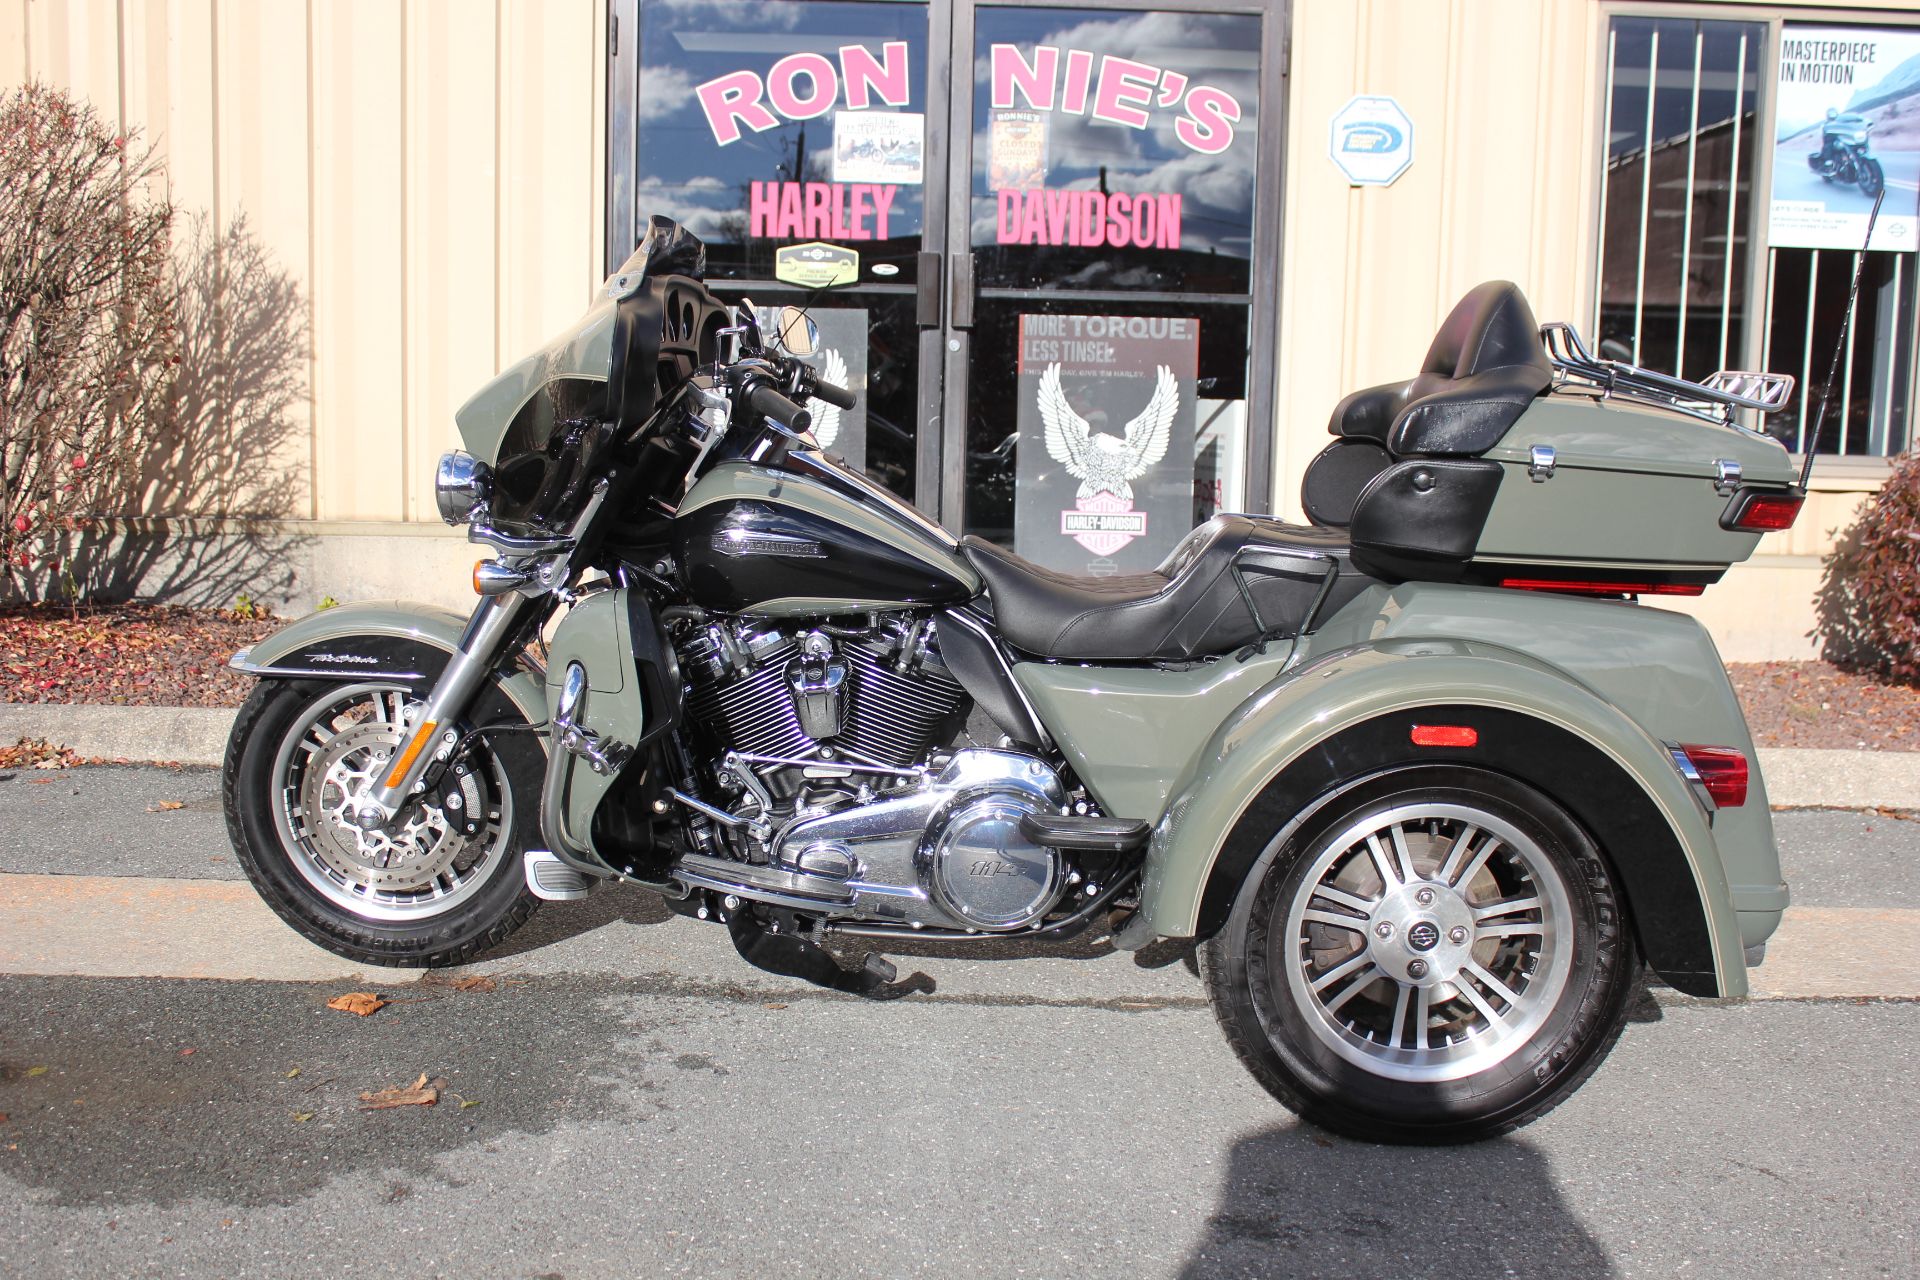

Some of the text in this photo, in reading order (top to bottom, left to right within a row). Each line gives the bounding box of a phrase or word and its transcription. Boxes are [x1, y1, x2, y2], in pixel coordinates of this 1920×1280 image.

[1782, 40, 1877, 64] MASTERPIECE
[1781, 62, 1854, 84] IN MOTION
[696, 41, 1241, 155] RON NIE'S
[996, 112, 1041, 122] RONNIE'S
[750, 181, 1182, 250] HARLEY DAVIDSON
[1024, 314, 1192, 340] MORE TORQUE.
[1024, 340, 1117, 363] LESS TINSEL.
[1067, 515, 1141, 530] HARLEY-DAVIDSON
[969, 860, 1027, 876] 114
